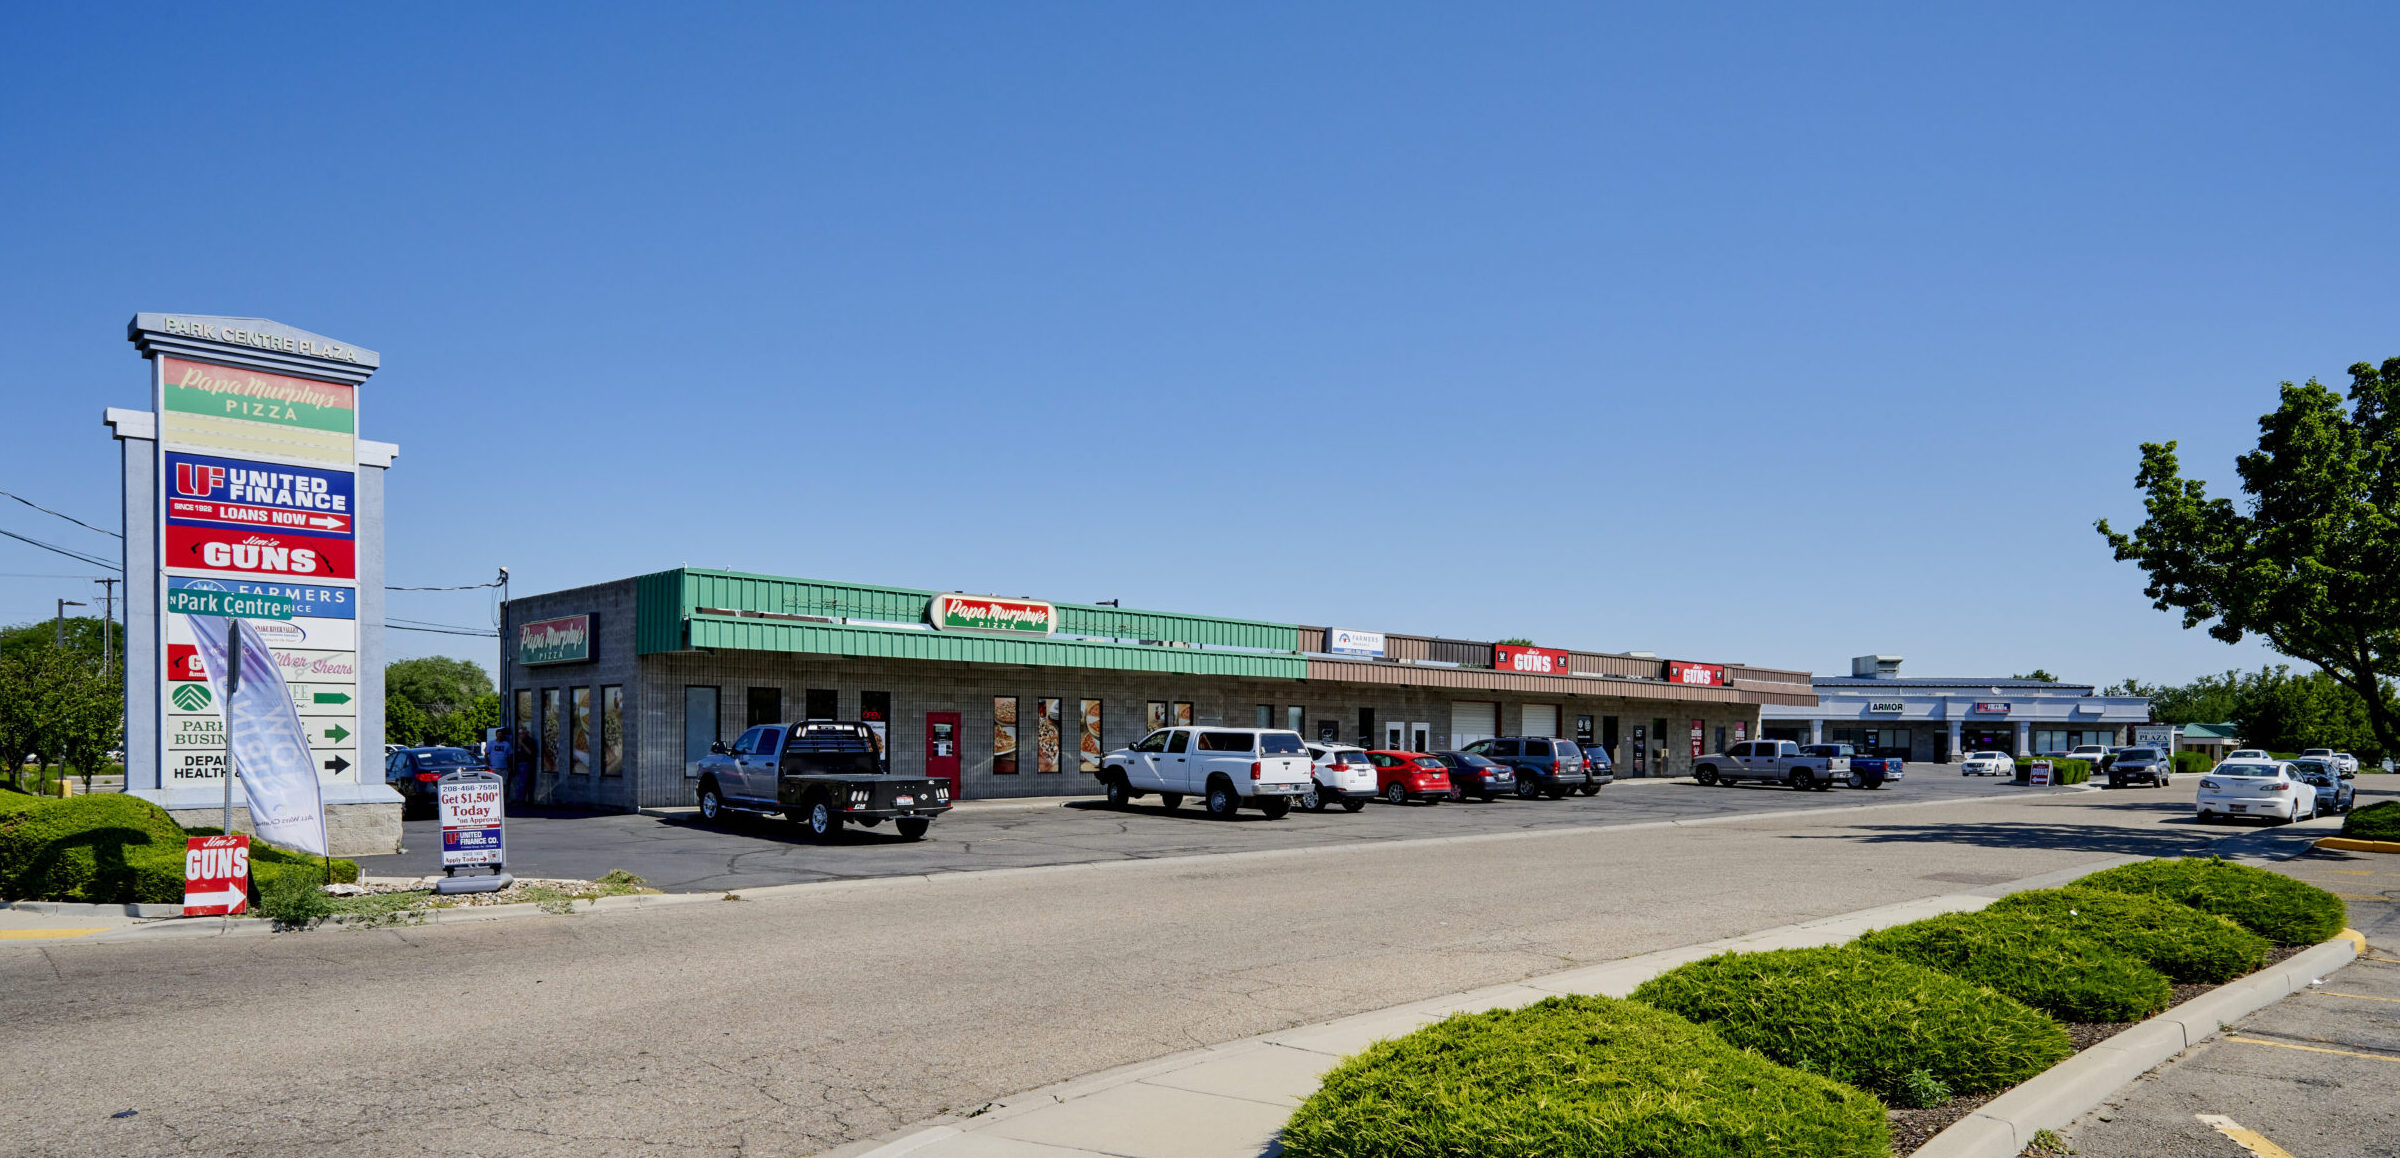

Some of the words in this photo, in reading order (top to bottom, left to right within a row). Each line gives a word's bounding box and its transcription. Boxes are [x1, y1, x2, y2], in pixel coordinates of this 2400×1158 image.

[164, 317, 216, 342] PARK
[221, 326, 294, 352] CENTRE
[298, 339, 358, 363] PLAZA
[179, 366, 243, 396] Papa
[225, 399, 298, 421] PIZZA
[230, 467, 328, 493] UNITED
[229, 484, 346, 511] FINANCE
[174, 502, 194, 511] SINCE
[219, 506, 269, 523] LOANS
[272, 508, 307, 526] NOW
[242, 535, 281, 548] Jim's
[203, 541, 317, 574] GUNS
[239, 585, 345, 603] FARMERS
[169, 595, 177, 605] N
[178, 593, 218, 612] Park
[223, 596, 280, 617] Centre
[947, 599, 987, 621] Papa
[988, 604, 1047, 627] Murphy's
[978, 621, 1016, 630] PIZZA
[520, 627, 545, 654] Papa
[539, 651, 563, 660] PIZZA
[1514, 653, 1551, 672] GUNS
[311, 658, 354, 674] Shears
[1683, 668, 1711, 685] GUNS
[1872, 703, 1903, 711] ARMOR
[862, 711, 882, 720] OPEN
[174, 734, 227, 745] BUSIN
[174, 767, 226, 778] HEALTH
[441, 794, 459, 804] Get
[451, 805, 491, 817] Today
[202, 836, 238, 847] Jim's
[460, 831, 482, 839] UNITED
[460, 837, 487, 845] FINANCE
[487, 836, 499, 844] CO.
[185, 846, 249, 881] GUNS
